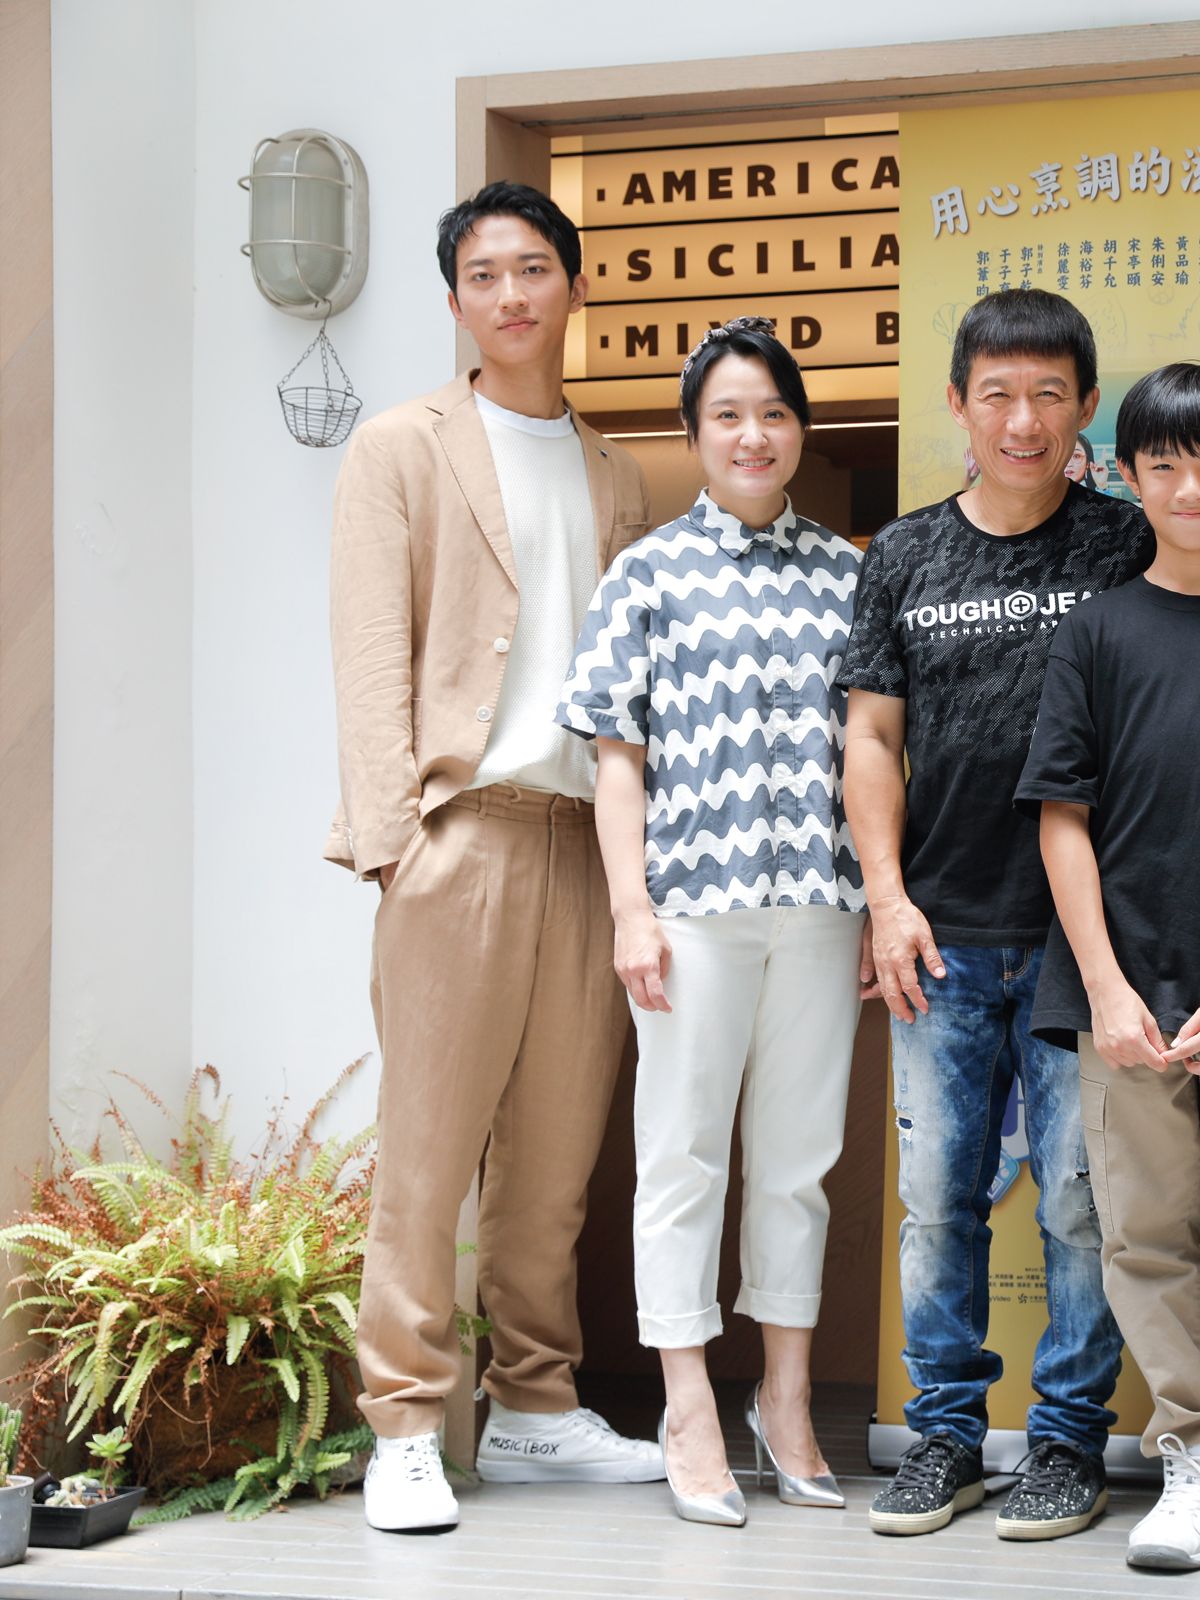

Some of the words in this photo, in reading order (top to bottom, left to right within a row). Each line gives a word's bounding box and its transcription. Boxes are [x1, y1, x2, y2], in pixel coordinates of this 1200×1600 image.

[1080, 239, 1093, 289] 海裕芬
[1104, 239, 1117, 288] 胡千允
[1151, 236, 1165, 286] 朱俐安
[625, 316, 823, 358] MID
[903, 599, 1001, 632] TOUGH
[930, 623, 1027, 641] TECHNICAL
